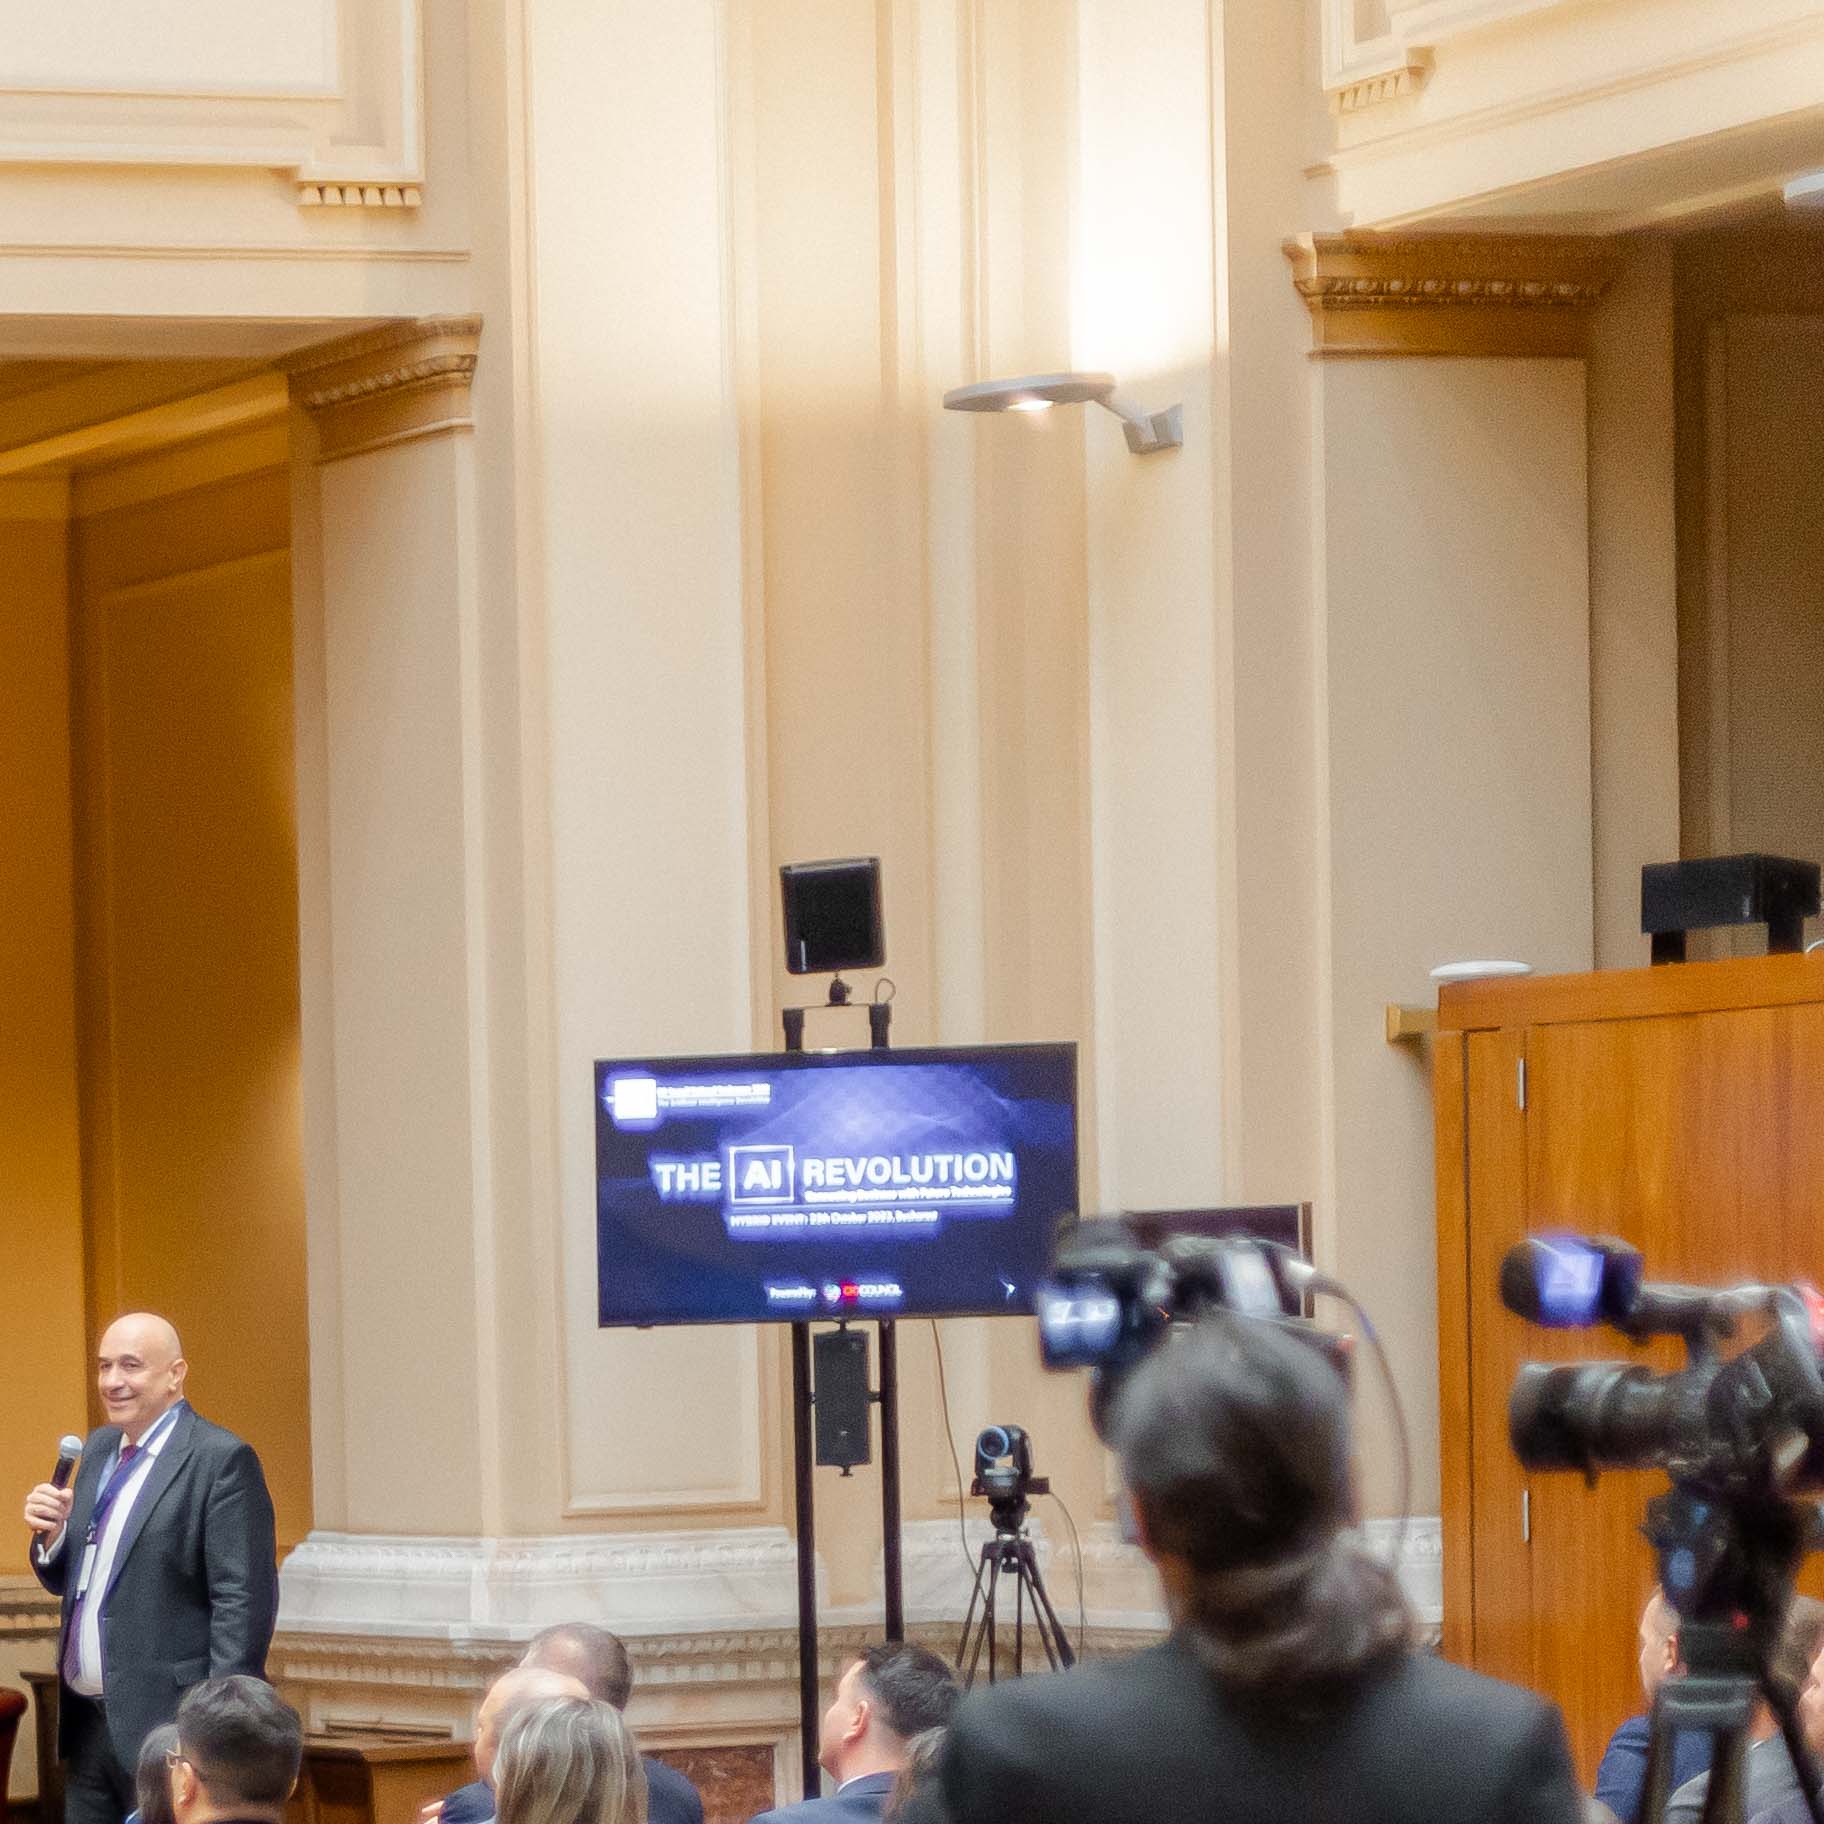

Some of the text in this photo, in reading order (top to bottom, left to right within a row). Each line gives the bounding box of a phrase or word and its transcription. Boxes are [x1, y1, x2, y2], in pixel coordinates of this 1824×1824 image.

[655, 1152, 1014, 1193] THE AI REVOLUTION
